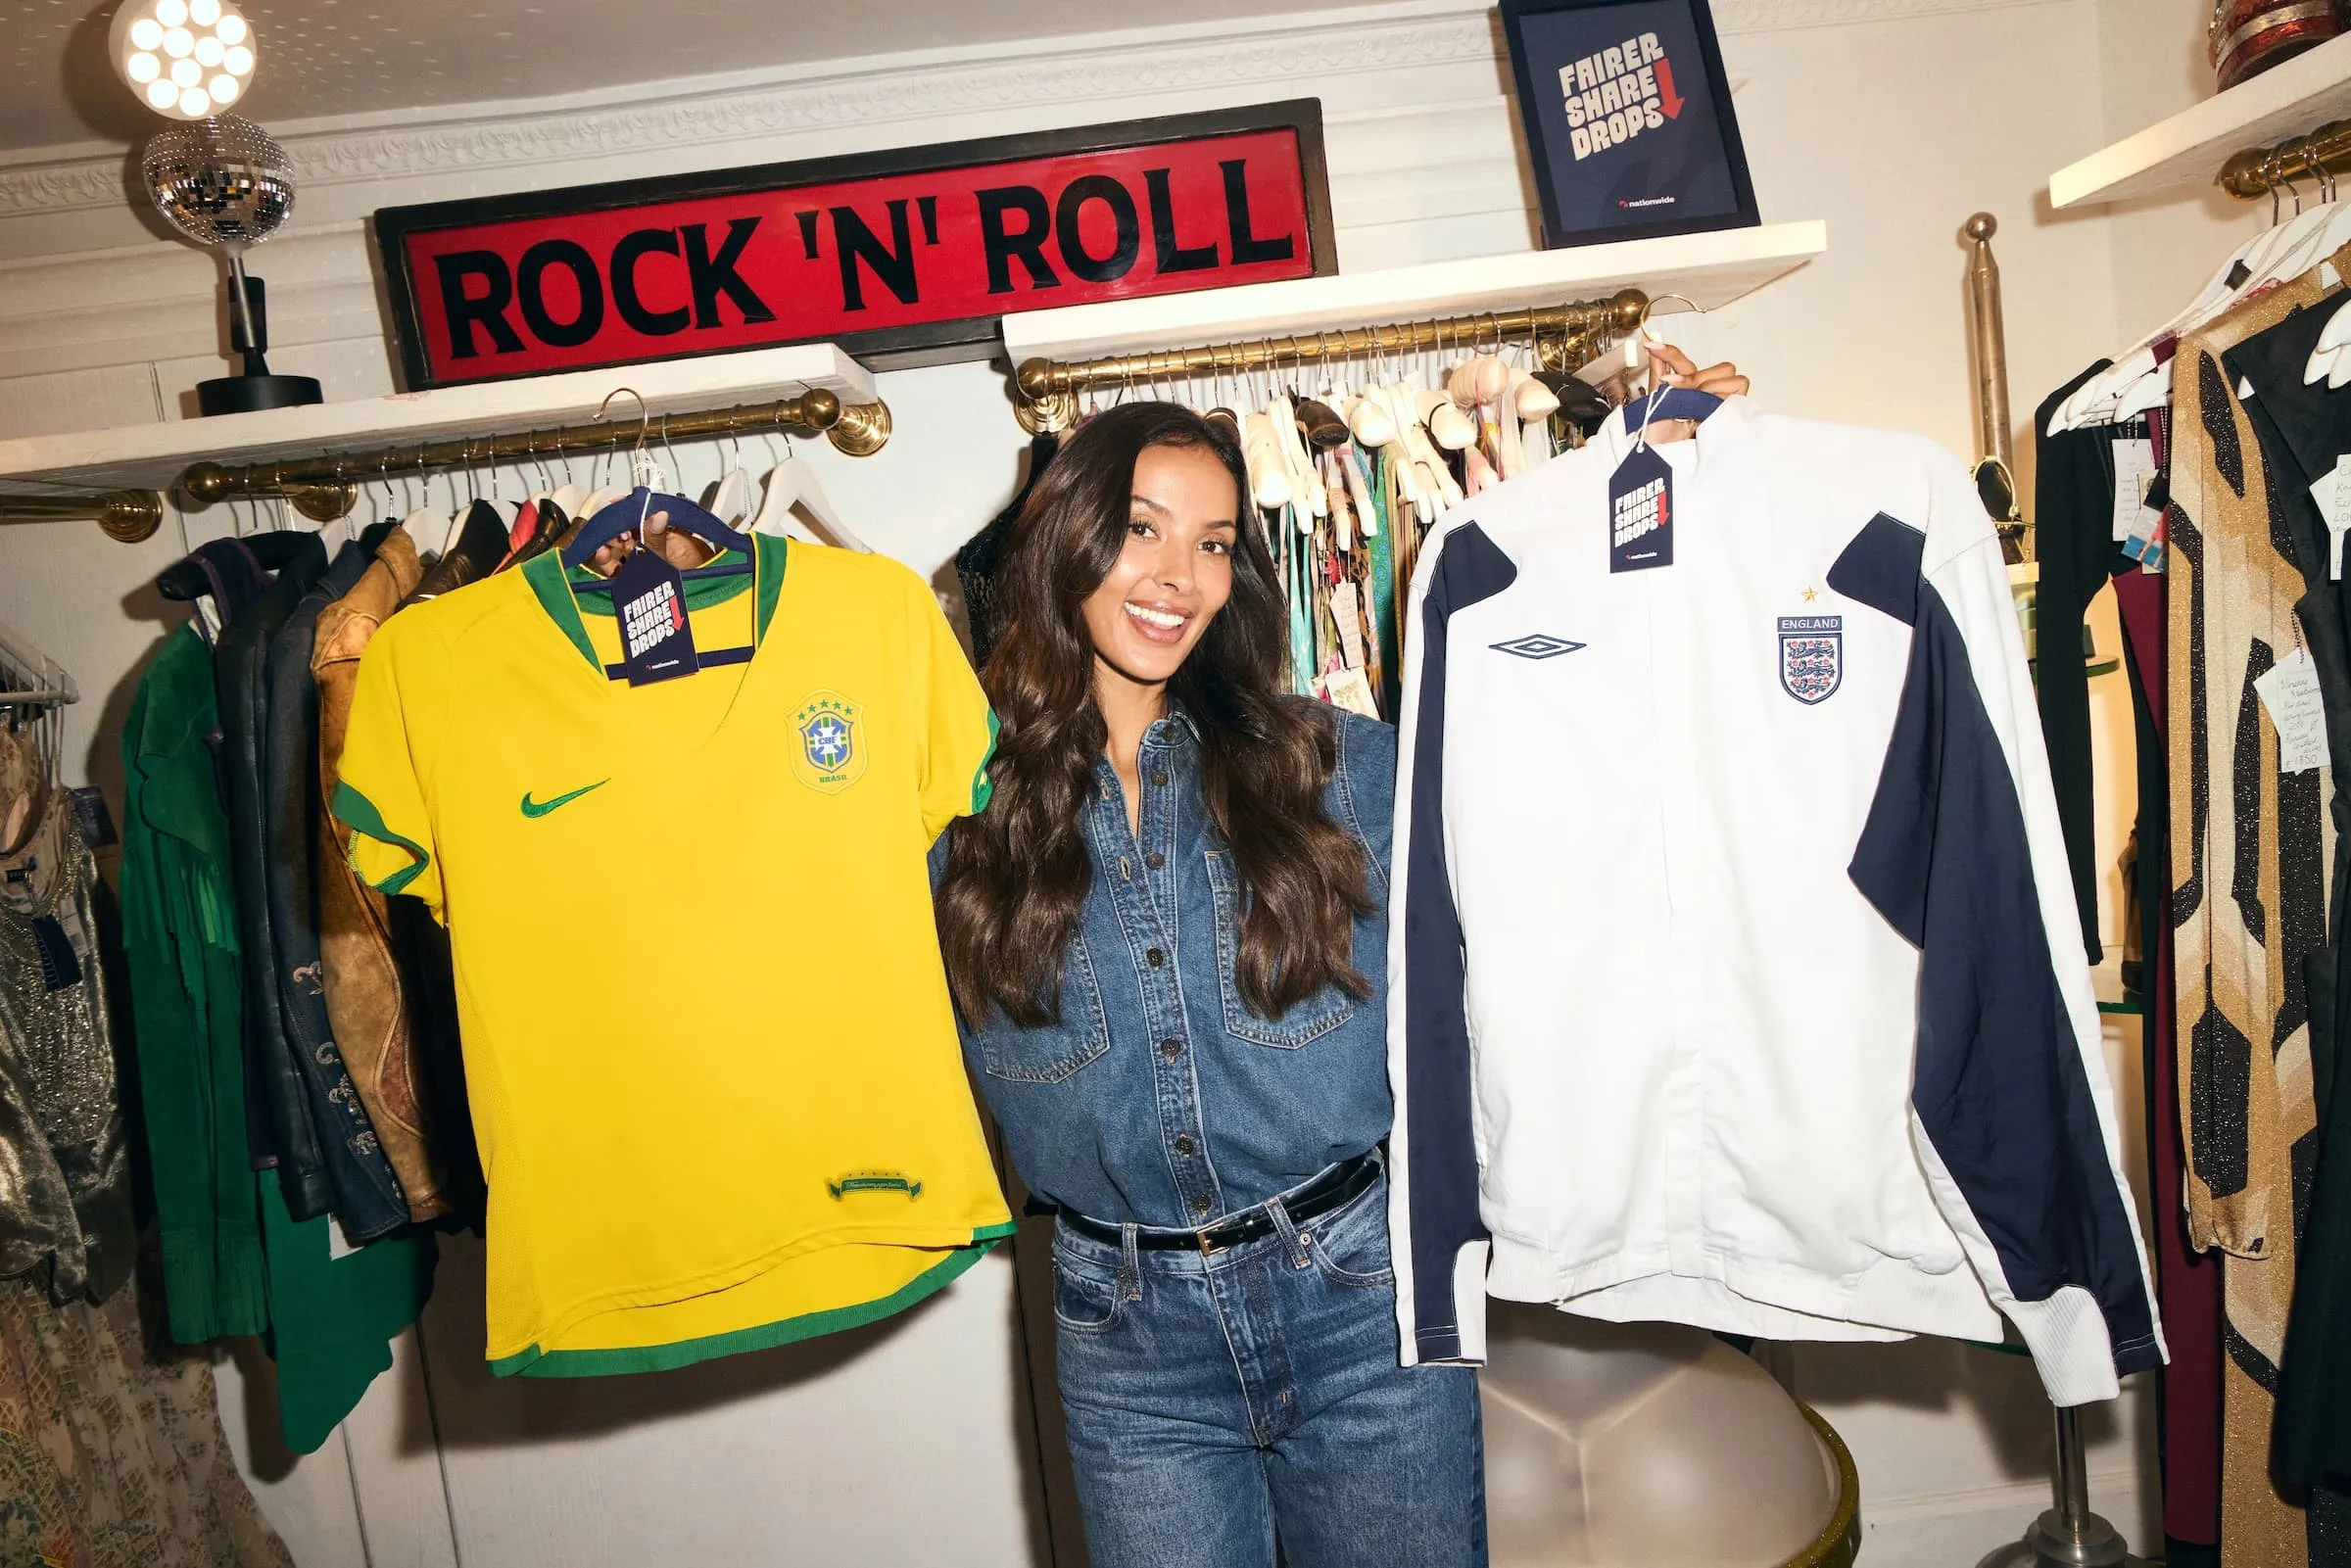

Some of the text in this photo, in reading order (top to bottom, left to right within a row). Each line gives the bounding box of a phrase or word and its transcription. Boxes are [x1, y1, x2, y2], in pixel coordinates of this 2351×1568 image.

[1559, 32, 1664, 98] FAIRER
[1564, 66, 1657, 127] SHARE
[1570, 97, 1664, 161] DROPS
[1628, 196, 1675, 208] nationwide
[431, 217, 777, 360] ROCK
[976, 160, 1293, 294] ROLL
[1615, 477, 1665, 514] FAIRER
[1615, 496, 1658, 530] SHARE
[1615, 513, 1658, 547] DROPS
[624, 581, 675, 622] FAIRER
[627, 600, 671, 640] SHARE
[630, 618, 675, 658] DROPS
[1782, 618, 1839, 629] ENGLAND
[819, 774, 848, 784] BRASIL
